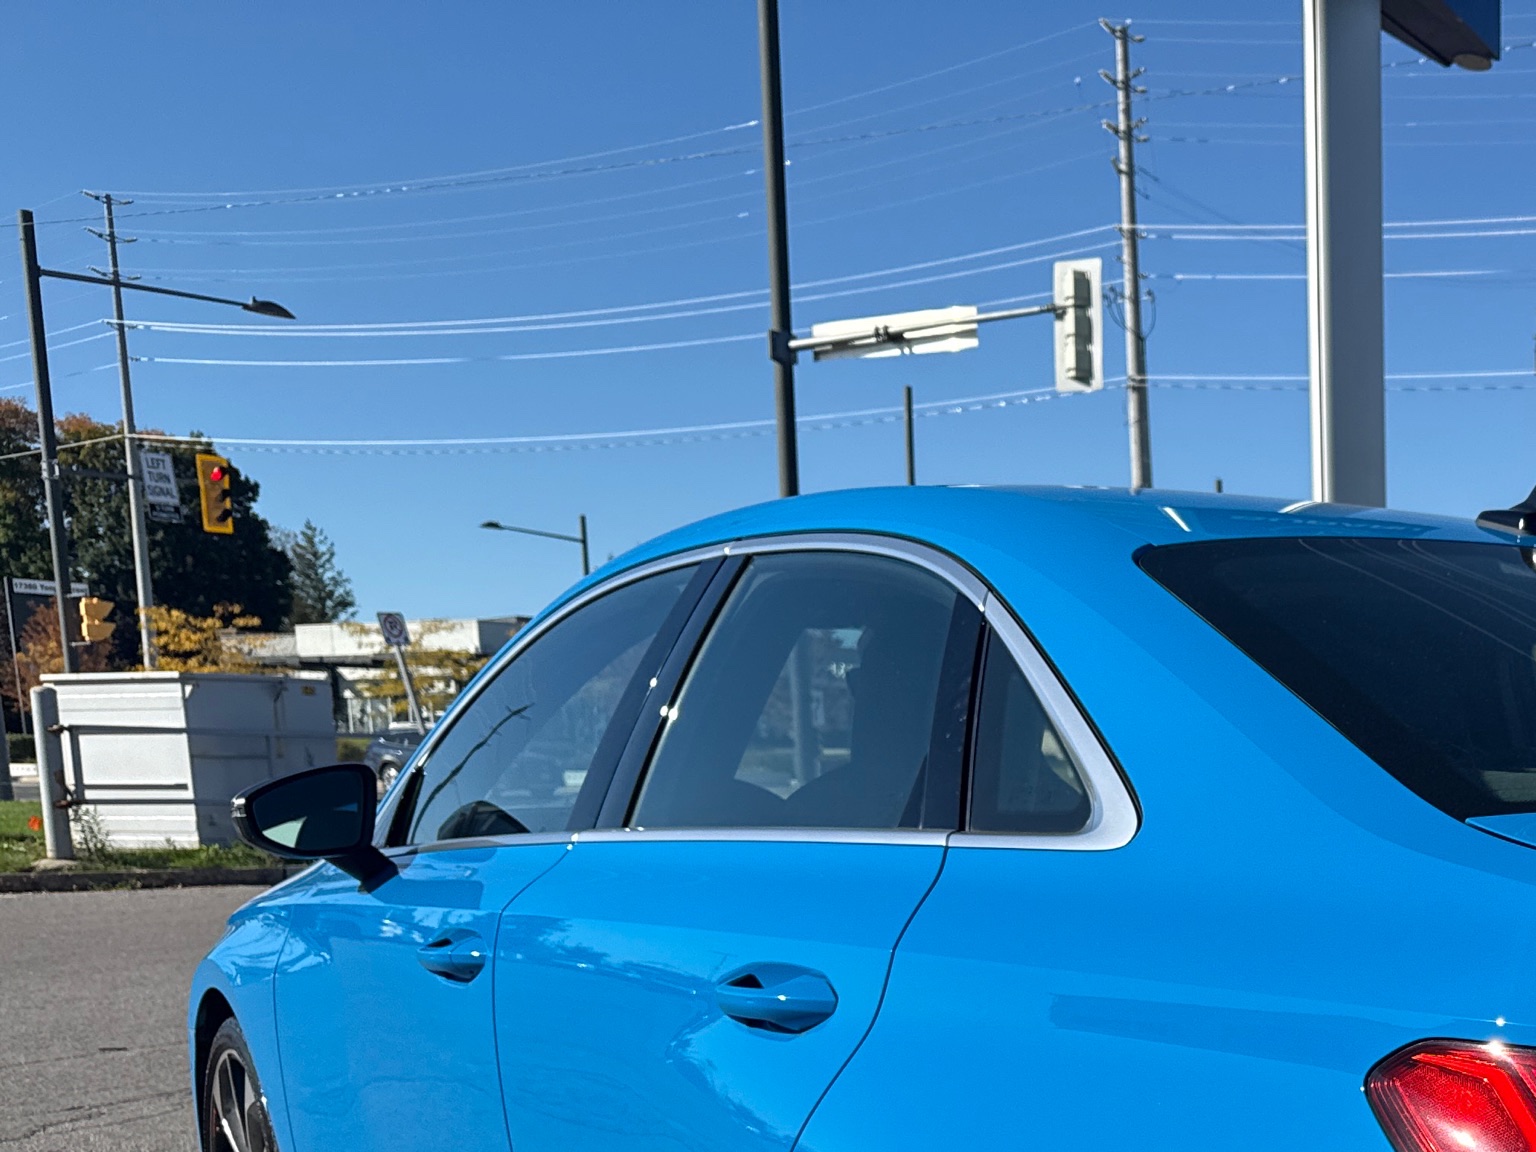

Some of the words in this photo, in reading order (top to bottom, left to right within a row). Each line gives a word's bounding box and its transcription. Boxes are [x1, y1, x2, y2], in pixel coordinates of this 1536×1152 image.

[145, 456, 166, 470] LEFT
[148, 470, 171, 483] TURN
[147, 484, 176, 499] SIGNAL
